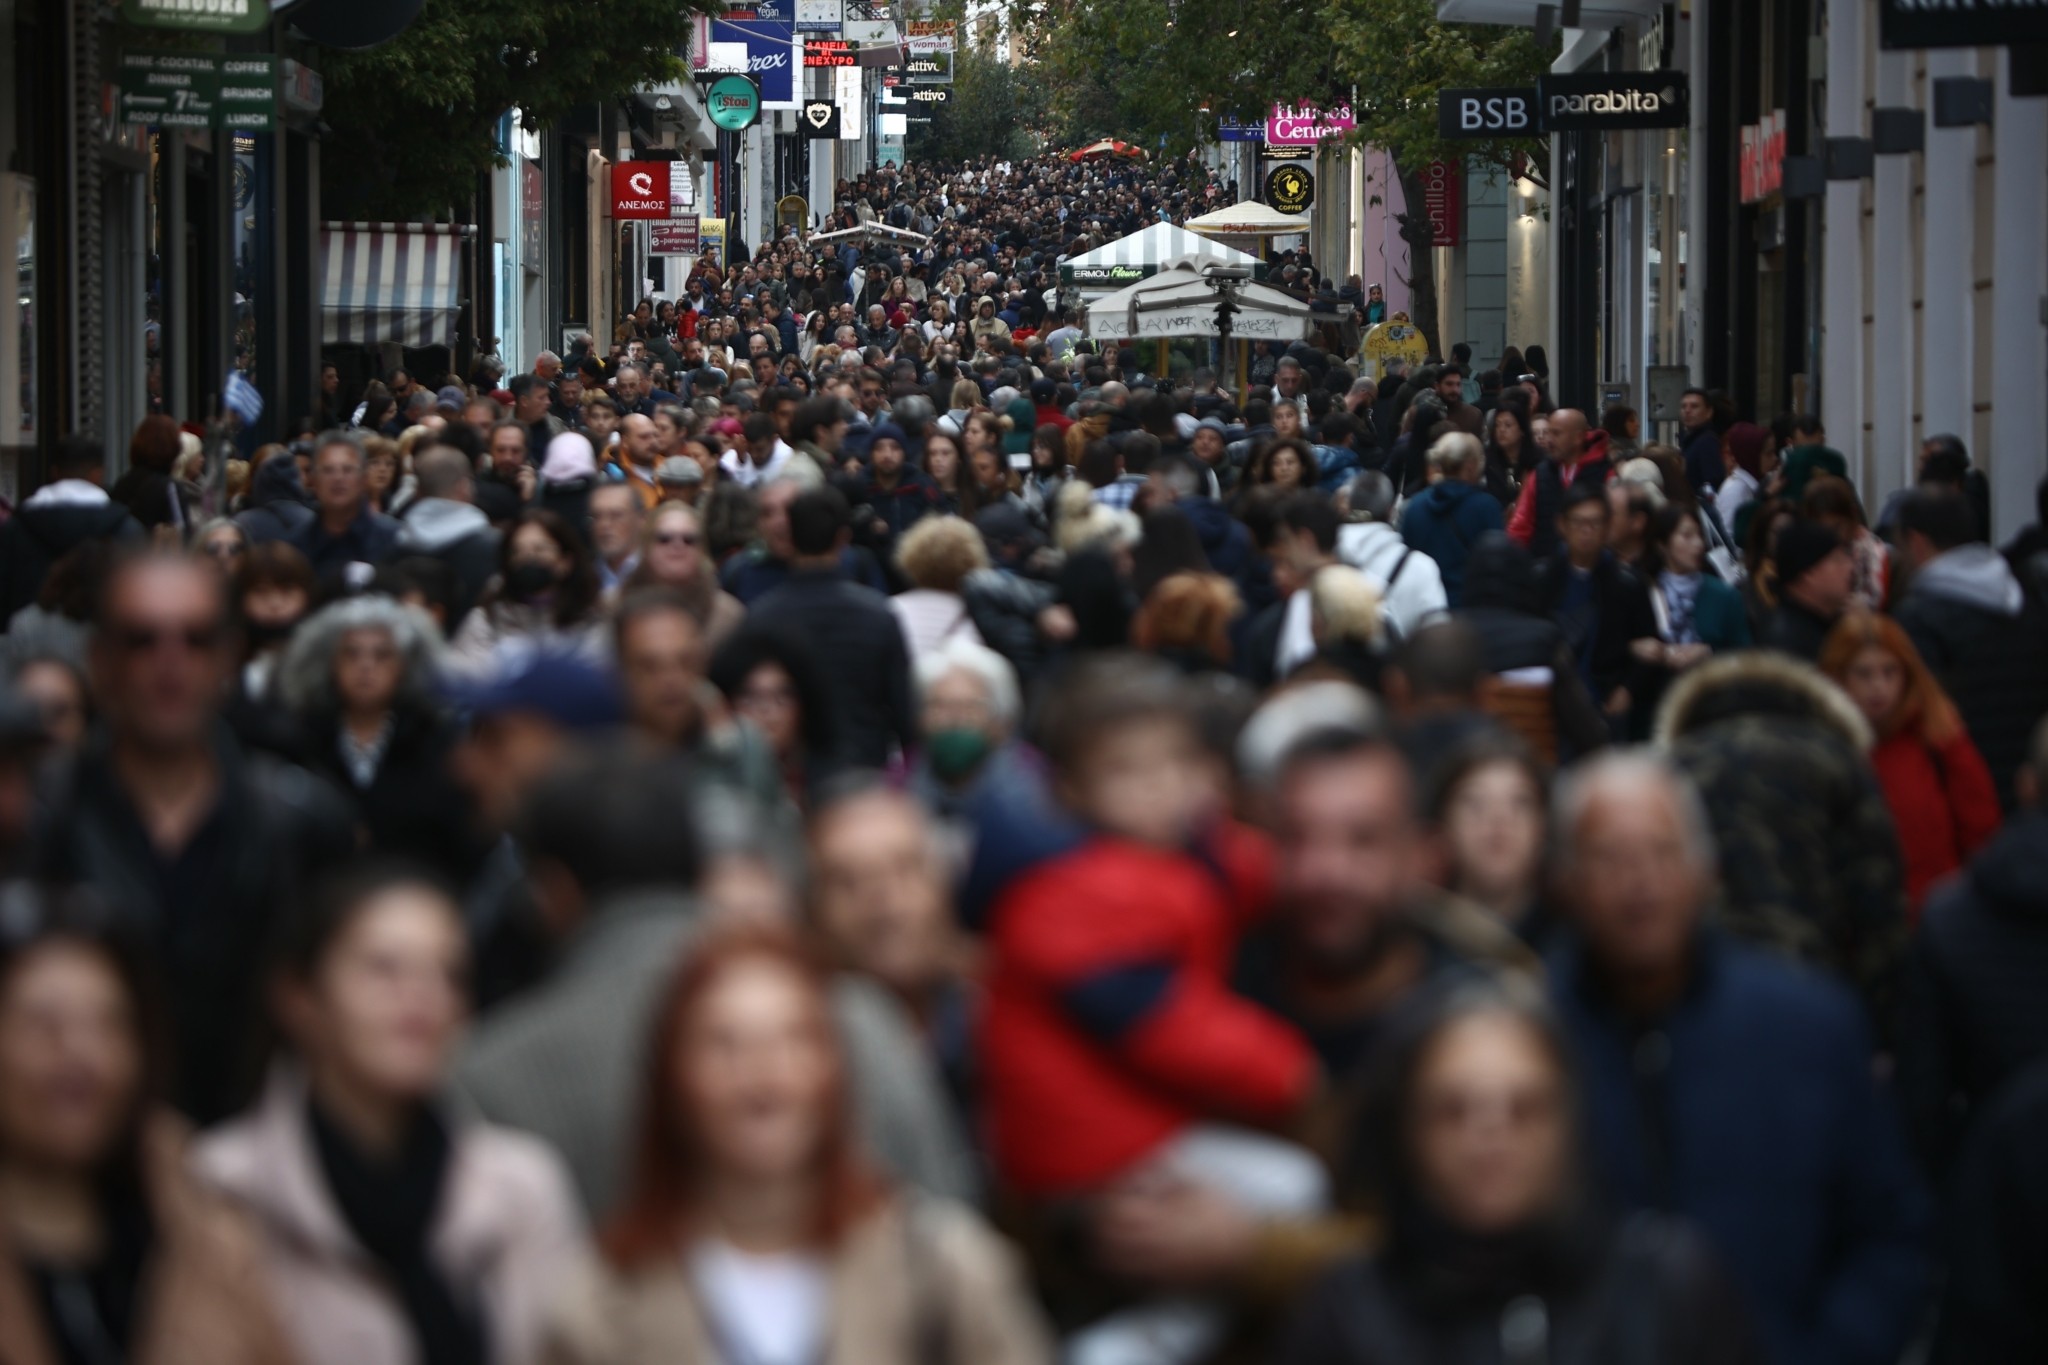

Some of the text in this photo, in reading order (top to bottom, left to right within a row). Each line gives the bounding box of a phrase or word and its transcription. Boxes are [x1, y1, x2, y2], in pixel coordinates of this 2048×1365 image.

[757, 6, 779, 18] Vegan
[223, 61, 271, 73] COFFEE
[148, 73, 192, 86] DINNER
[222, 88, 272, 99] BRUNCH
[913, 89, 946, 102] attivo
[1550, 88, 1660, 117] parabita
[128, 111, 209, 126] ROOF GARDEN
[226, 113, 268, 125] LUNCH
[1461, 97, 1529, 130] BSB
[618, 200, 666, 210] ΑΝΕΜΟΣ
[1074, 266, 1143, 279] ERMOU Flower
